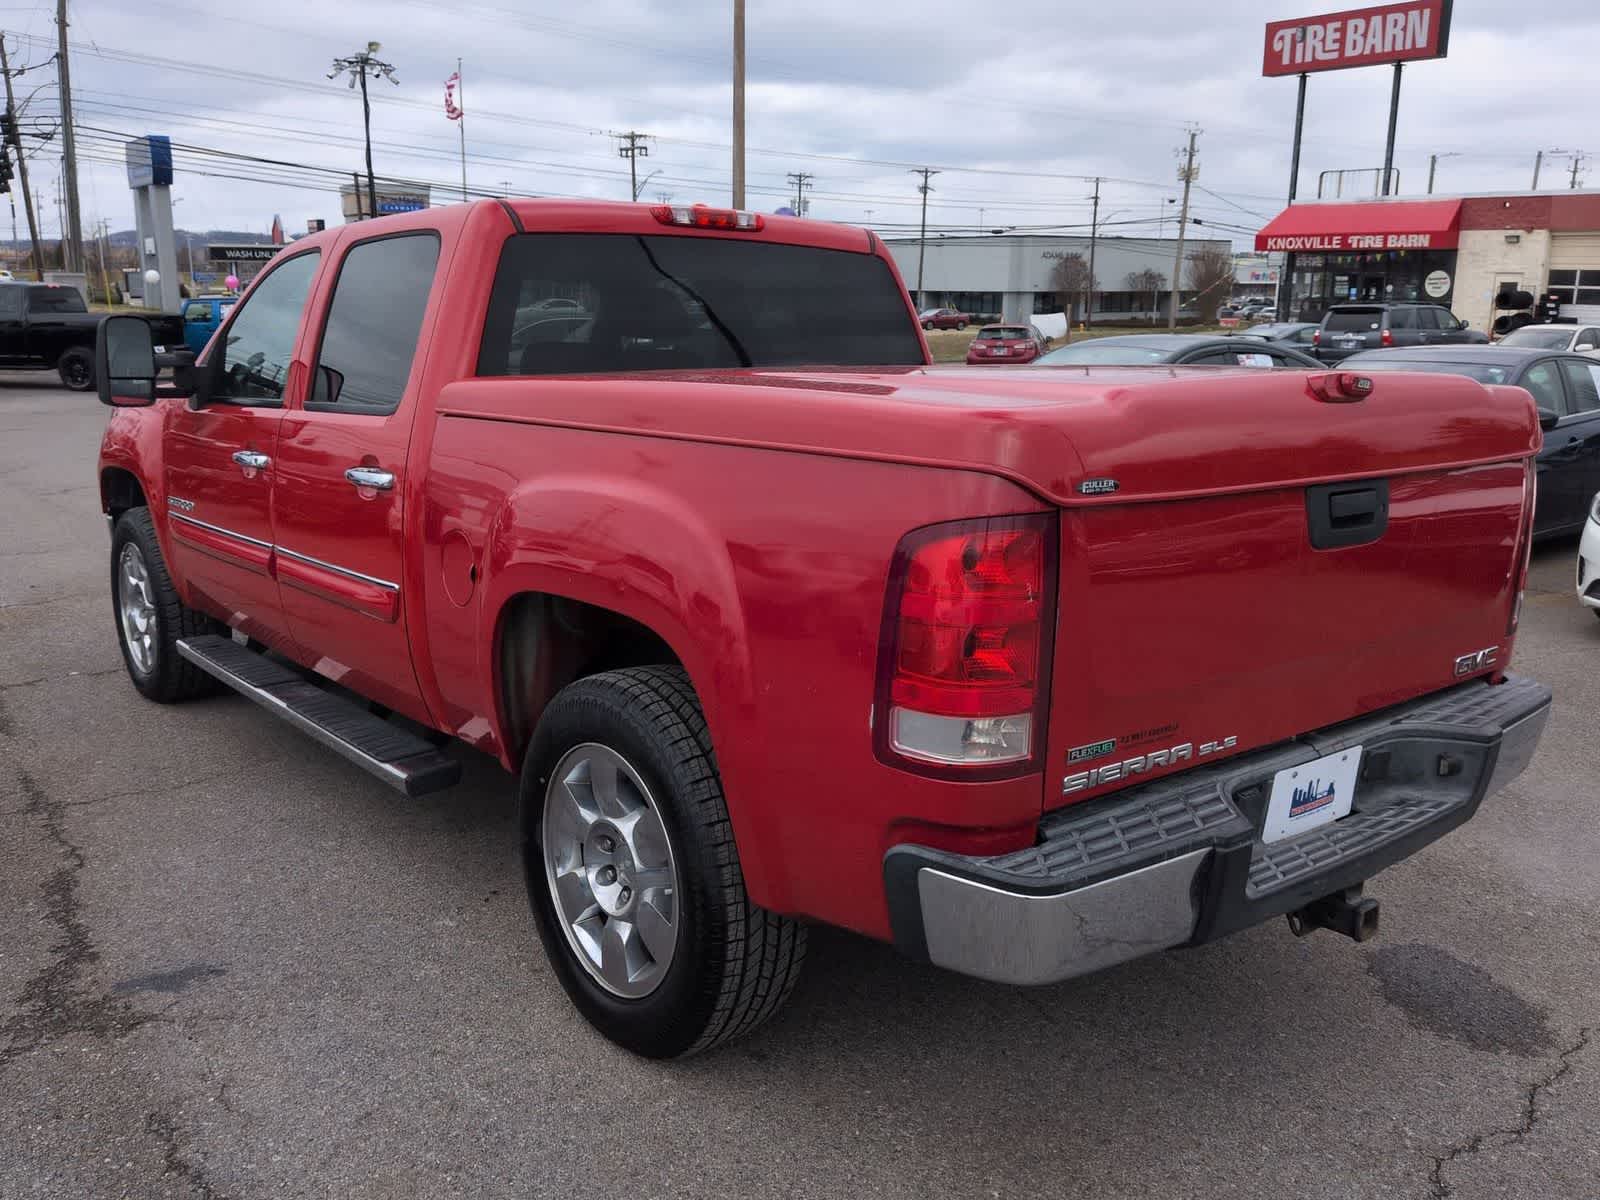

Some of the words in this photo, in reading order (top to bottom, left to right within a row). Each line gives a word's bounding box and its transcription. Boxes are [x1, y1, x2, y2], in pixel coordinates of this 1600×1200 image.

[1344, 8, 1431, 56] BARN
[1267, 236, 1342, 249] KNOXVILLE
[1387, 234, 1430, 248] BARN
[225, 250, 253, 258] WASH
[1082, 479, 1115, 493] FULLER
[1454, 645, 1499, 677] GMC
[1071, 742, 1113, 760] FLEXFUEL
[1063, 743, 1193, 793] SIERRA
